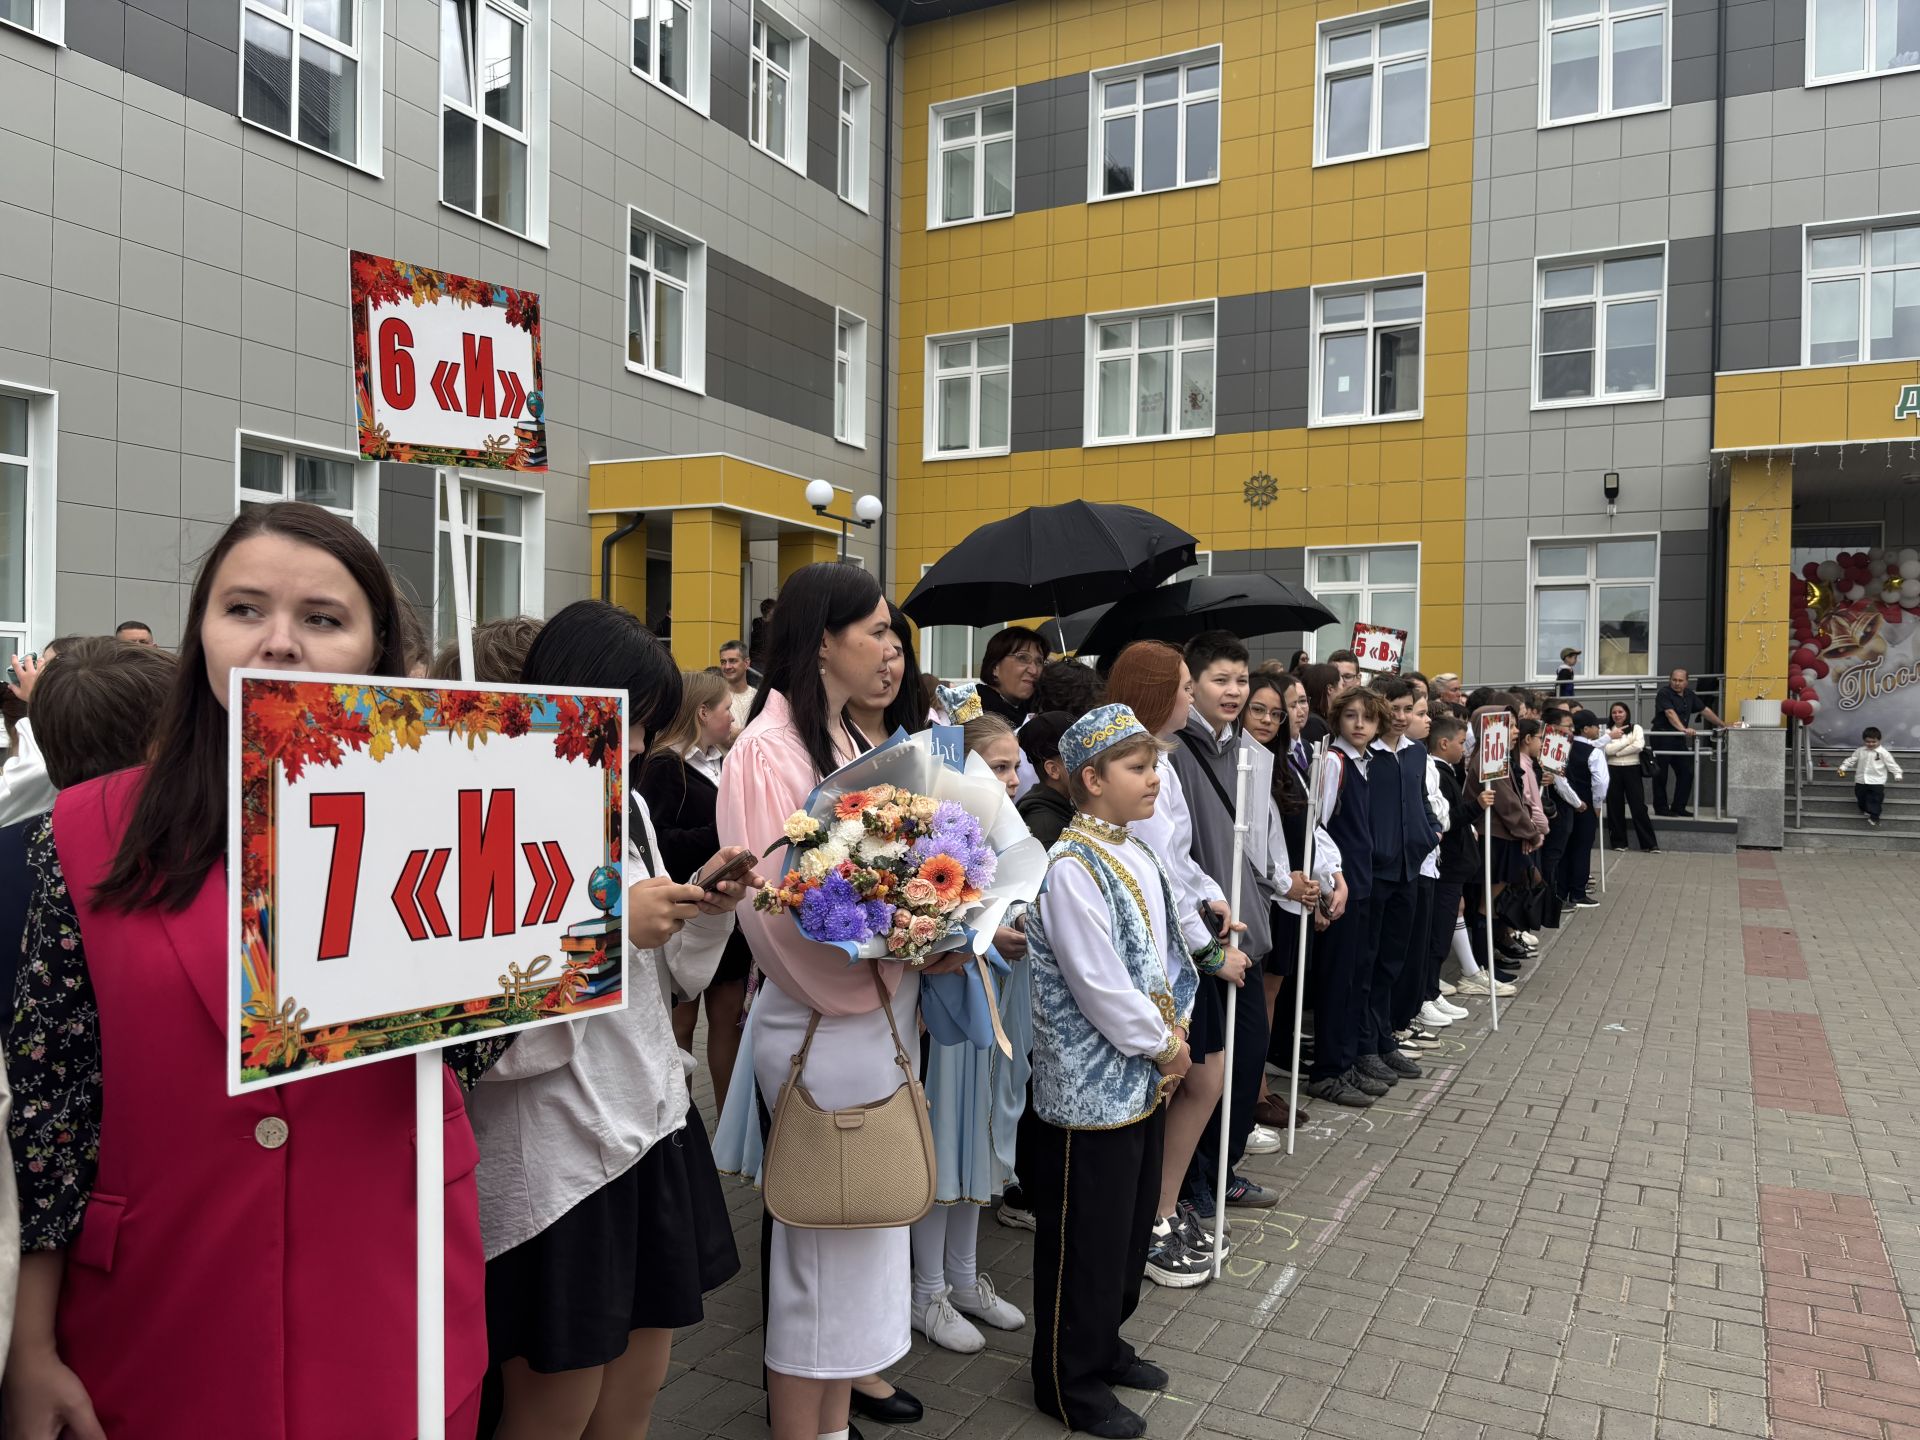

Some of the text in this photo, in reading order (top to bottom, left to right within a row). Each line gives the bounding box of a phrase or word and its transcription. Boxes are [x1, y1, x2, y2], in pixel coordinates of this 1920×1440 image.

[378, 316, 527, 420] 6 «И»
[1355, 637, 1399, 663] 5 «В»
[1484, 732, 1505, 764] 5 «Г»
[1543, 737, 1551, 757] 5
[308, 787, 576, 961] 7 «И»
